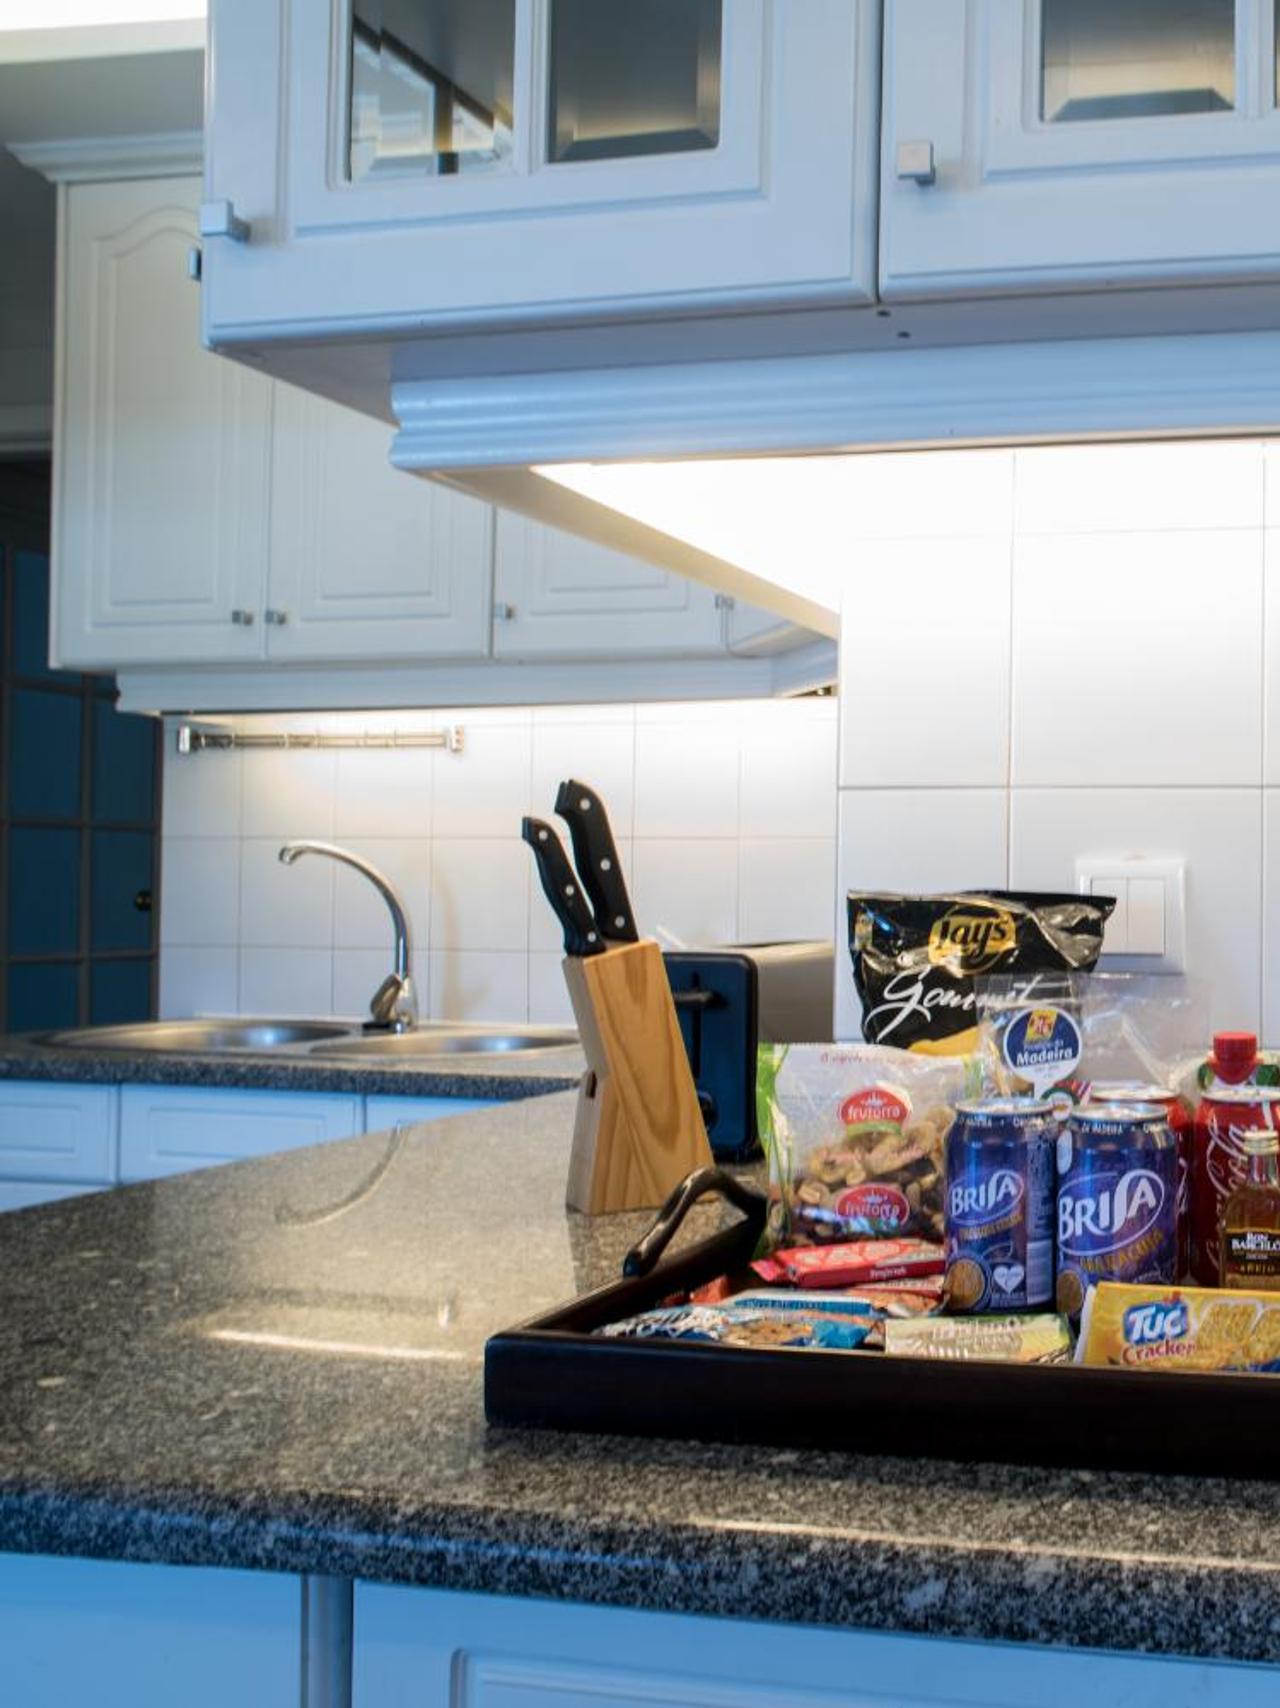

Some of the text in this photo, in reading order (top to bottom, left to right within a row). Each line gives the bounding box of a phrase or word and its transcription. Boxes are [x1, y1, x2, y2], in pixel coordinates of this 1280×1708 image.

[1016, 1045, 1073, 1067] Madeira
[951, 1170, 1018, 1217] BRISA
[1059, 1169, 1157, 1240] BRISA
[1128, 1305, 1183, 1339] TUC
